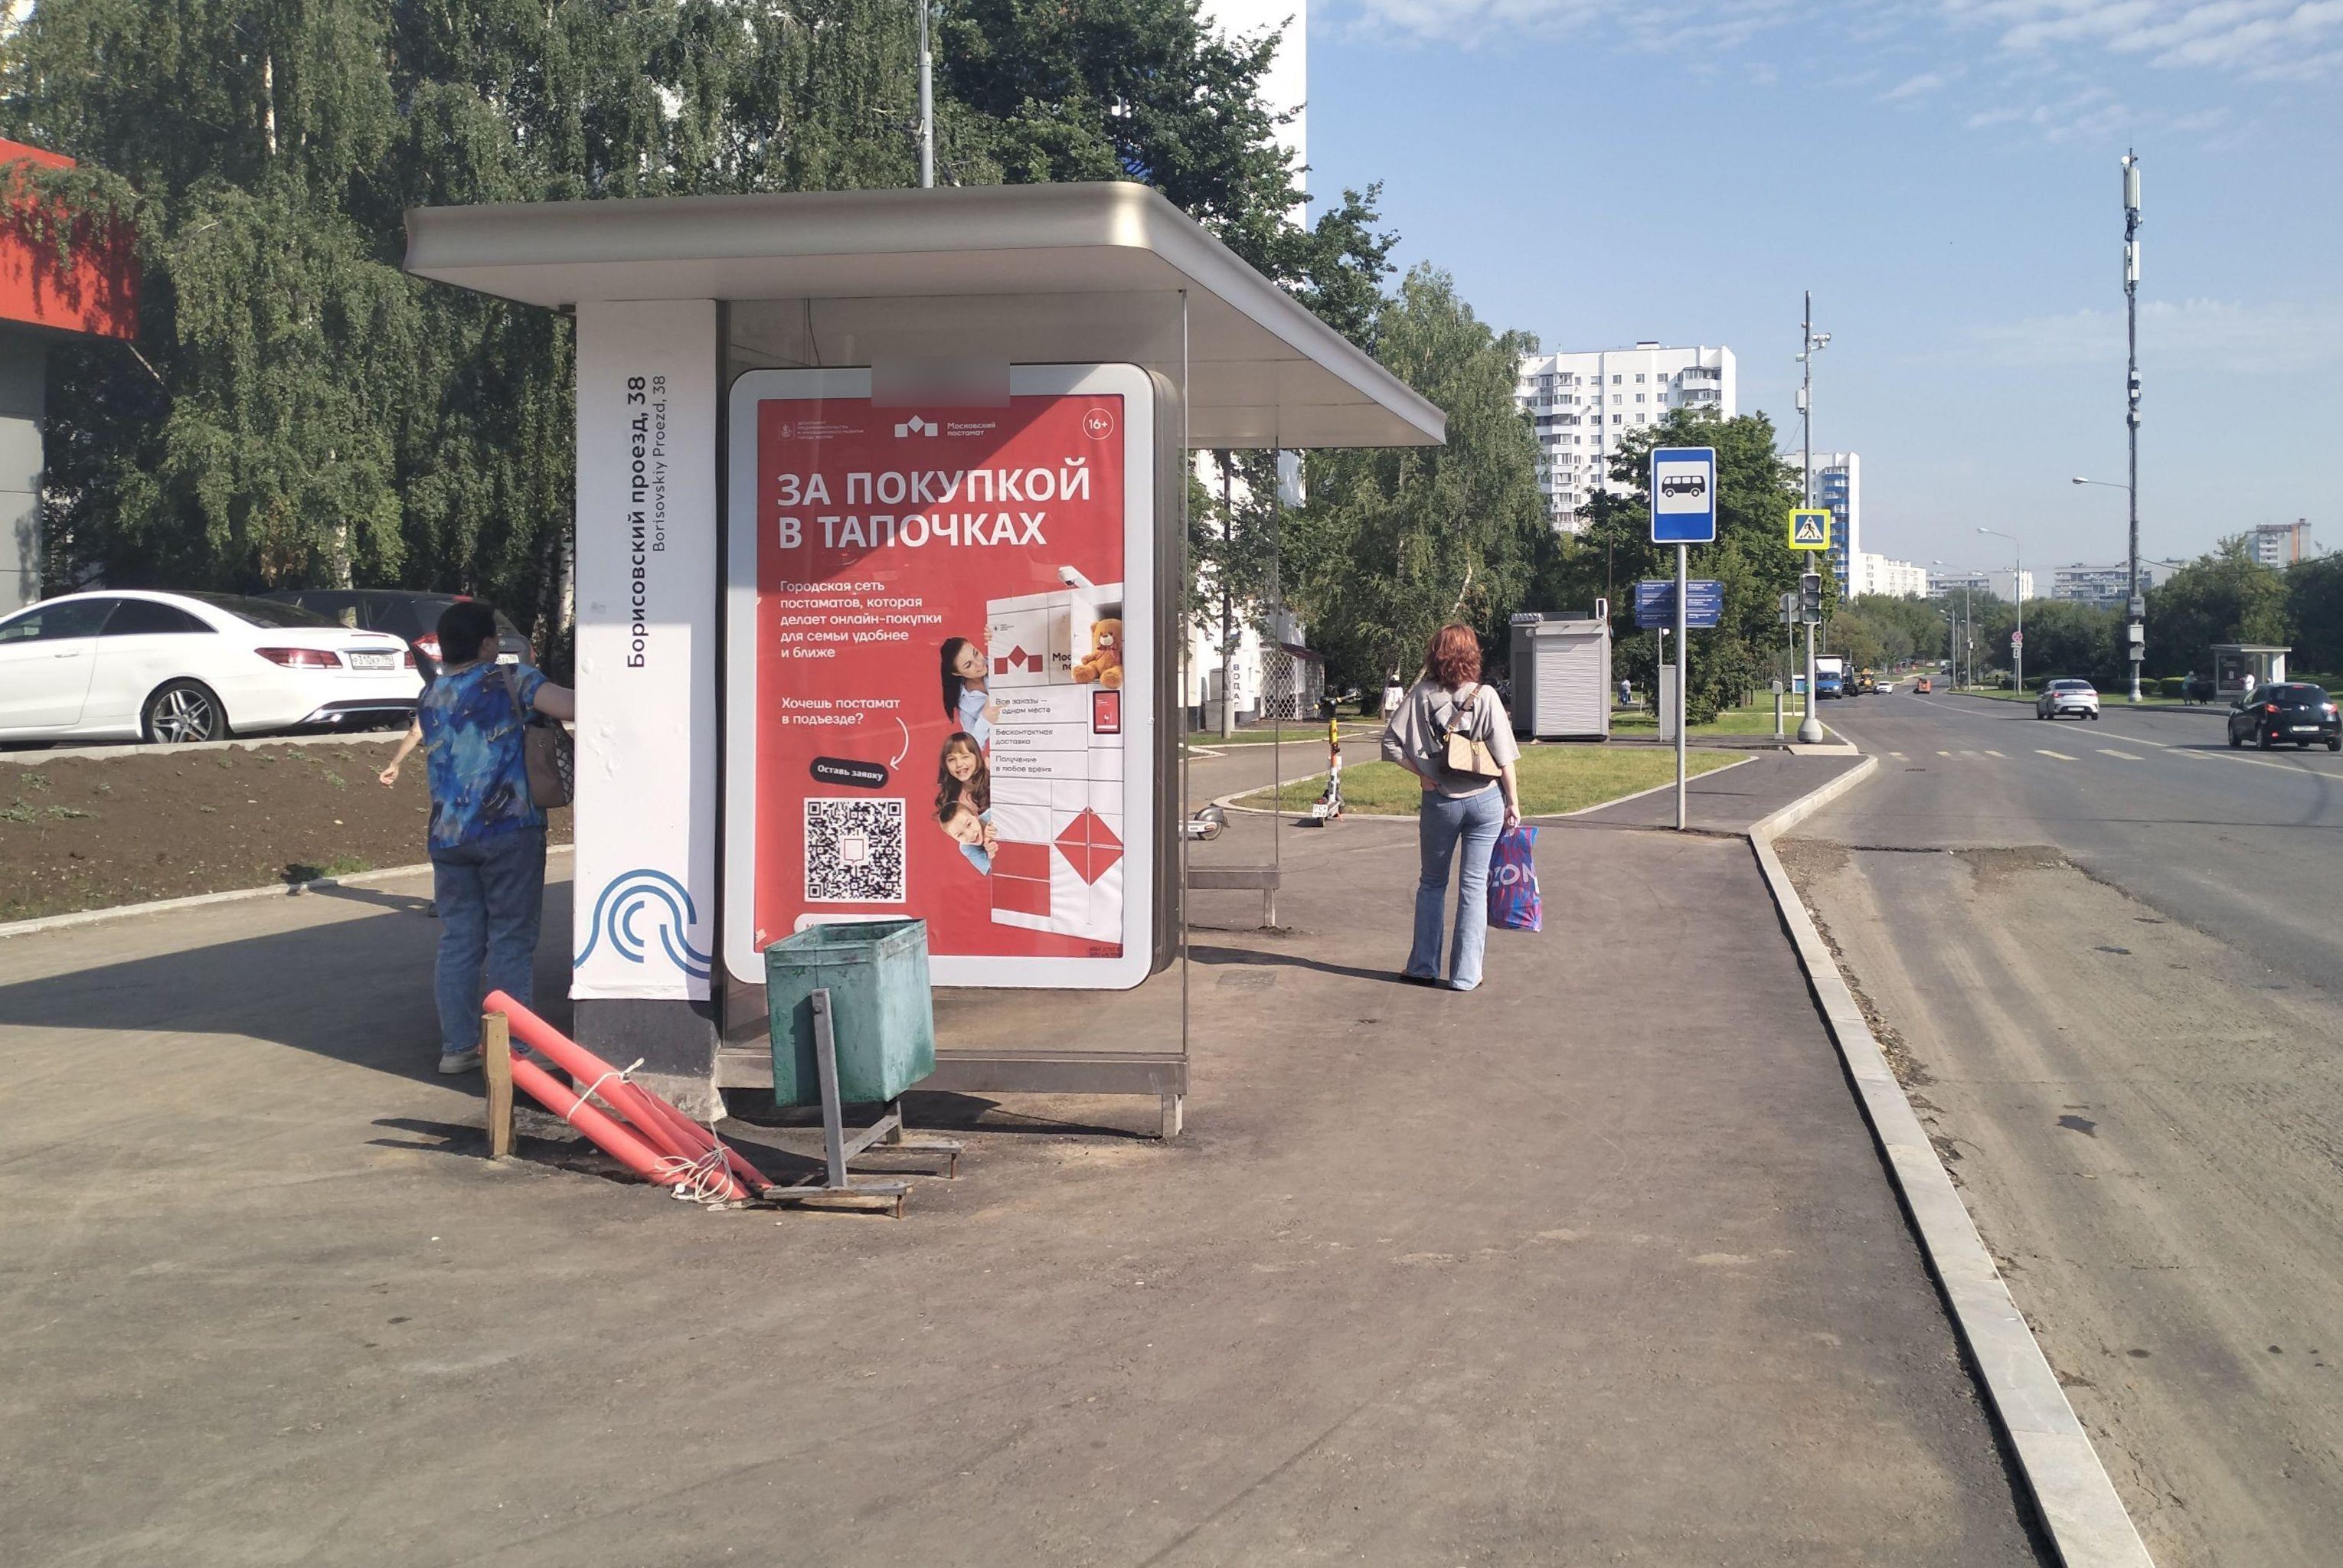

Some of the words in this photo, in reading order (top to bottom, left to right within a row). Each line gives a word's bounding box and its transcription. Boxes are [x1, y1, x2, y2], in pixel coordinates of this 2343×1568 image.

[627, 376, 646, 405] 38
[652, 375, 665, 394] 38
[652, 399, 668, 456] Proezd,
[947, 421, 996, 430] Московский
[1088, 418, 1108, 430] 16+
[630, 413, 649, 503] проезд,
[777, 473, 832, 506] ЗА
[847, 457, 1090, 505] ПОКУПКОЙ
[652, 462, 668, 551] Borisovskiy
[779, 516, 802, 549] В
[818, 511, 1047, 547] ТАПОЧКАХ
[627, 513, 649, 668] Борисовский
[779, 580, 851, 594] Городская
[854, 582, 885, 593] сеть
[780, 599, 863, 610] постаматов,
[867, 598, 923, 610] которая
[780, 616, 826, 626] делает
[830, 612, 942, 626] онлайн-покупки
[780, 632, 803, 642] для
[806, 632, 849, 642] семьи
[851, 629, 909, 643] удобнее
[781, 649, 789, 658] и
[793, 646, 835, 658] ближе
[782, 697, 832, 710] Хочешь
[835, 698, 901, 709] постамат
[782, 716, 789, 724] в
[792, 713, 864, 726] подъезде?
[995, 756, 1037, 764] Получение
[817, 764, 851, 776] Оставь
[851, 770, 884, 782] заявку
